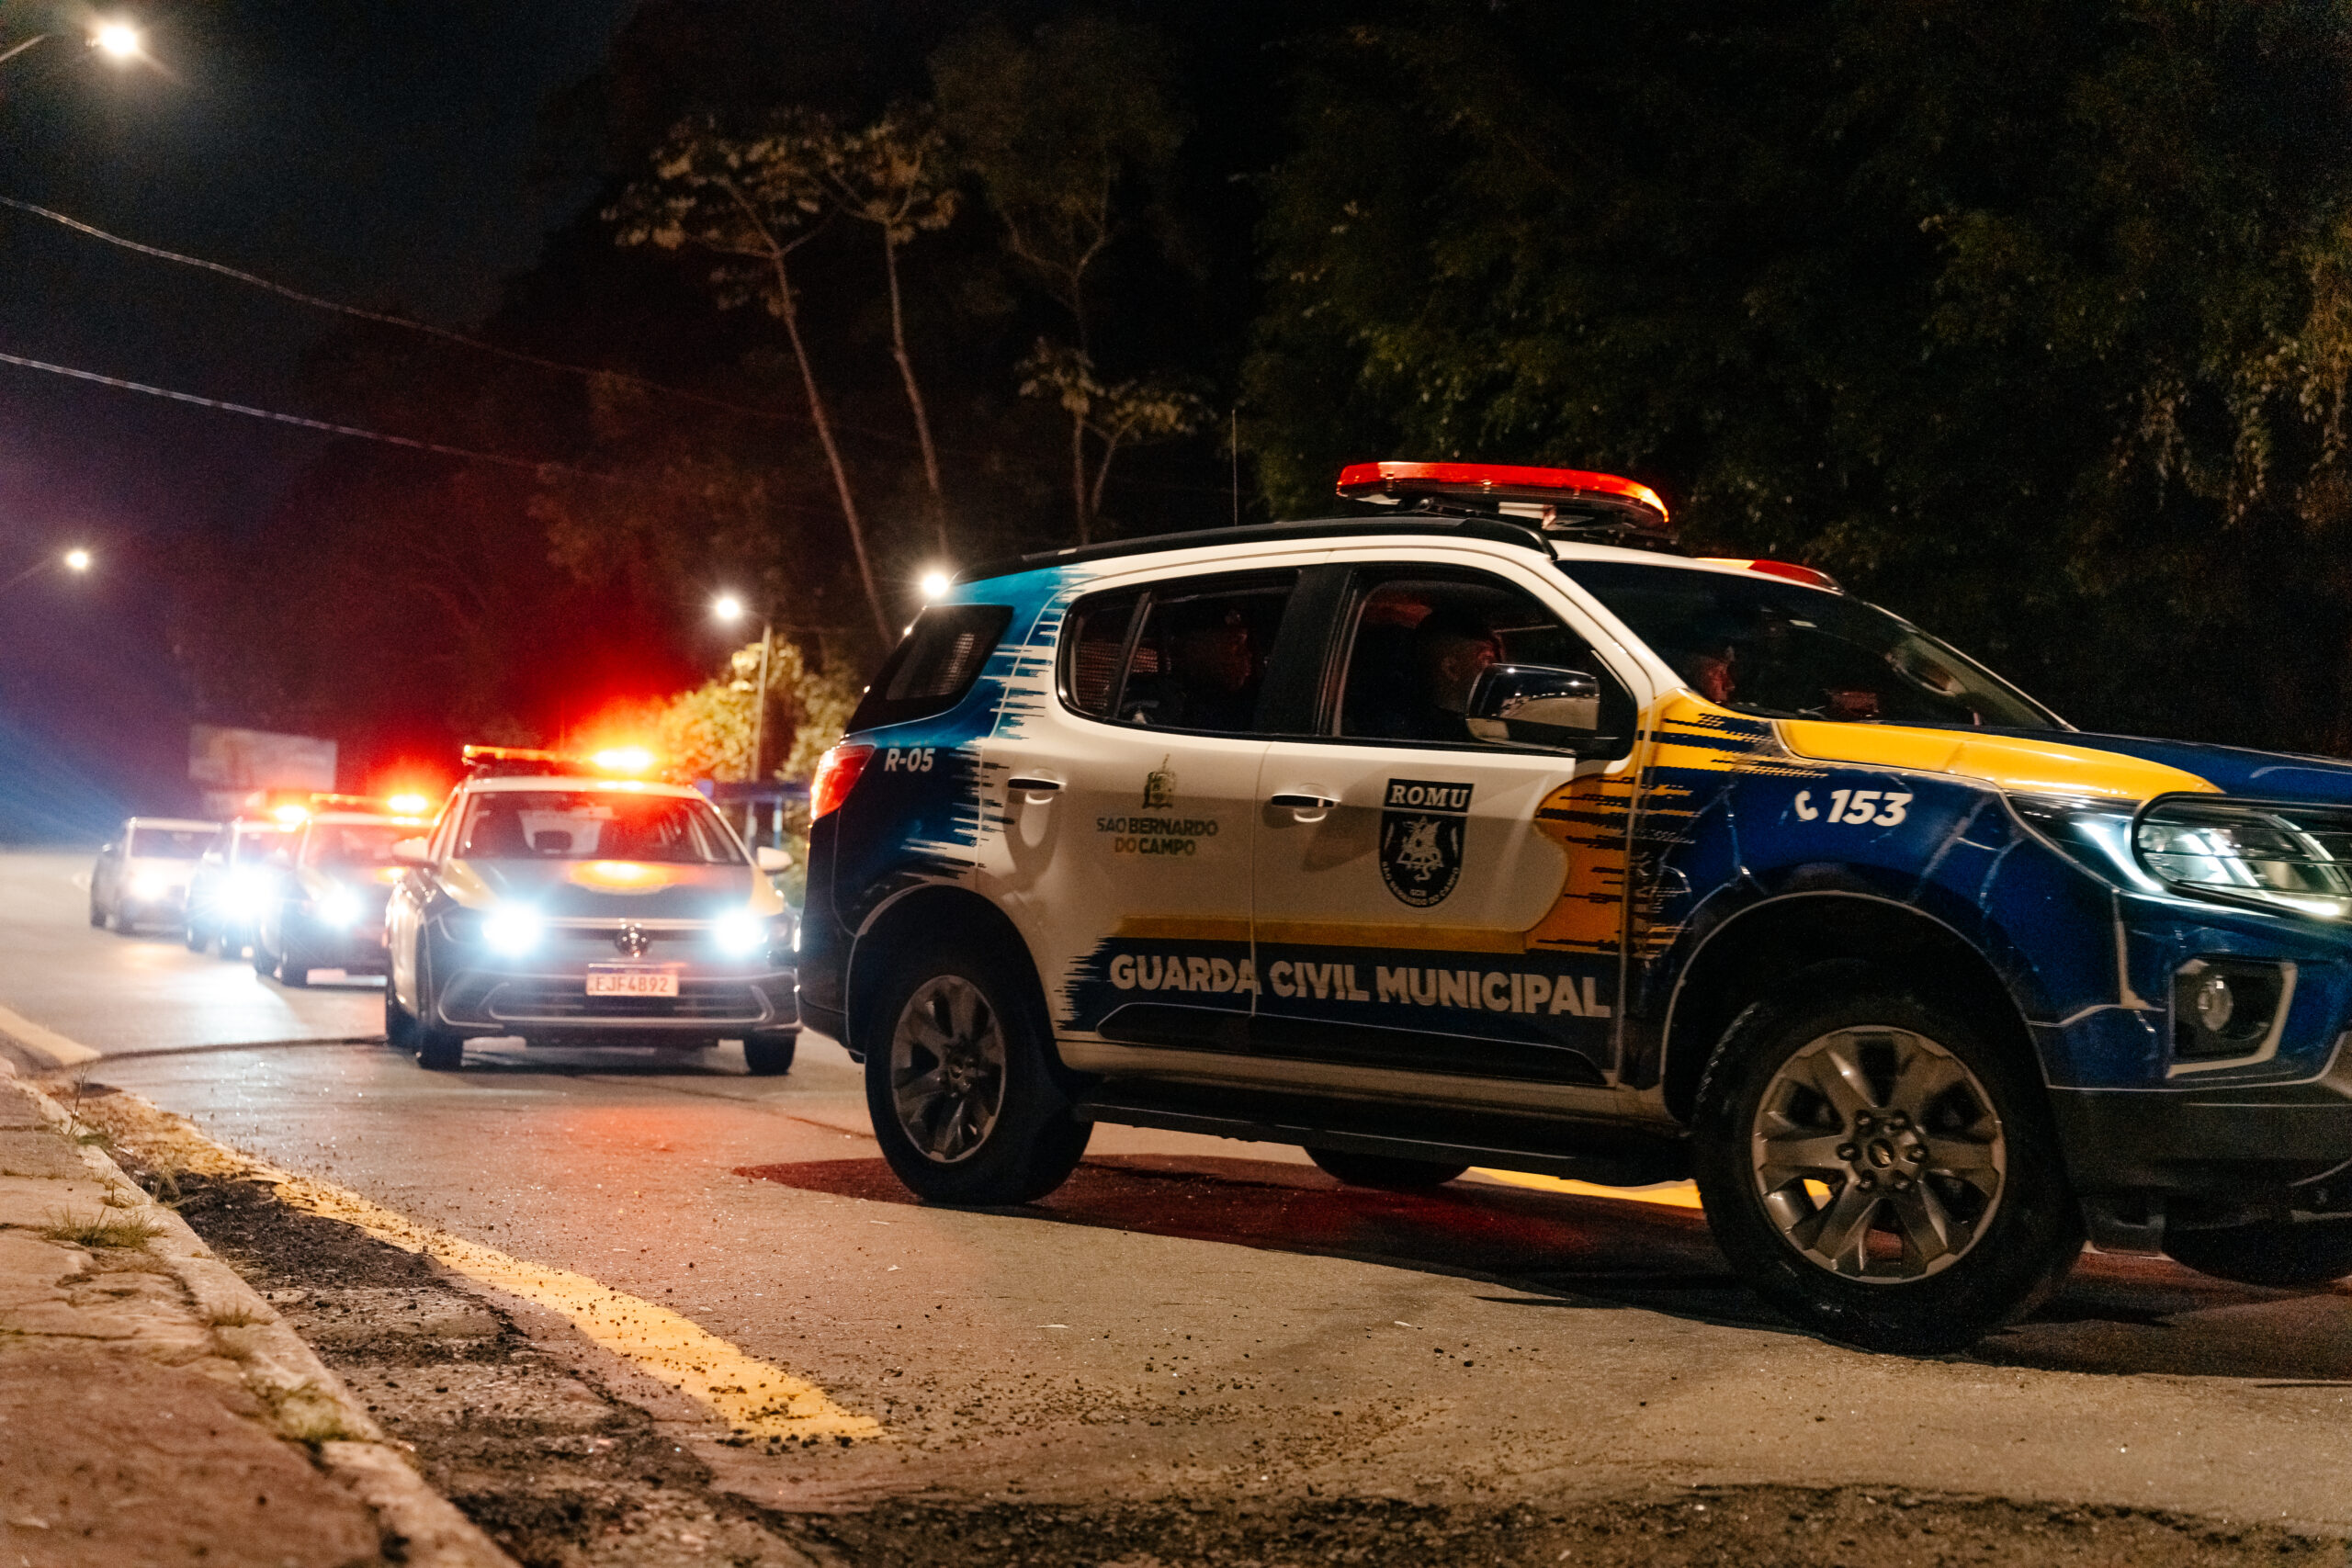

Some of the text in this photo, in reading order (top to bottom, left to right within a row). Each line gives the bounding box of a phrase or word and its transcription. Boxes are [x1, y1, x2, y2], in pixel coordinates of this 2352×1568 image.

[884, 748, 935, 772] R-05
[1389, 784, 1470, 808] ROMU
[1826, 789, 1914, 827] 153
[1128, 817, 1218, 837] BERNARDO
[1114, 836, 1196, 856] DO CAMPO
[1110, 953, 1611, 1019] GUARDA CIVIL MUNICIPAL
